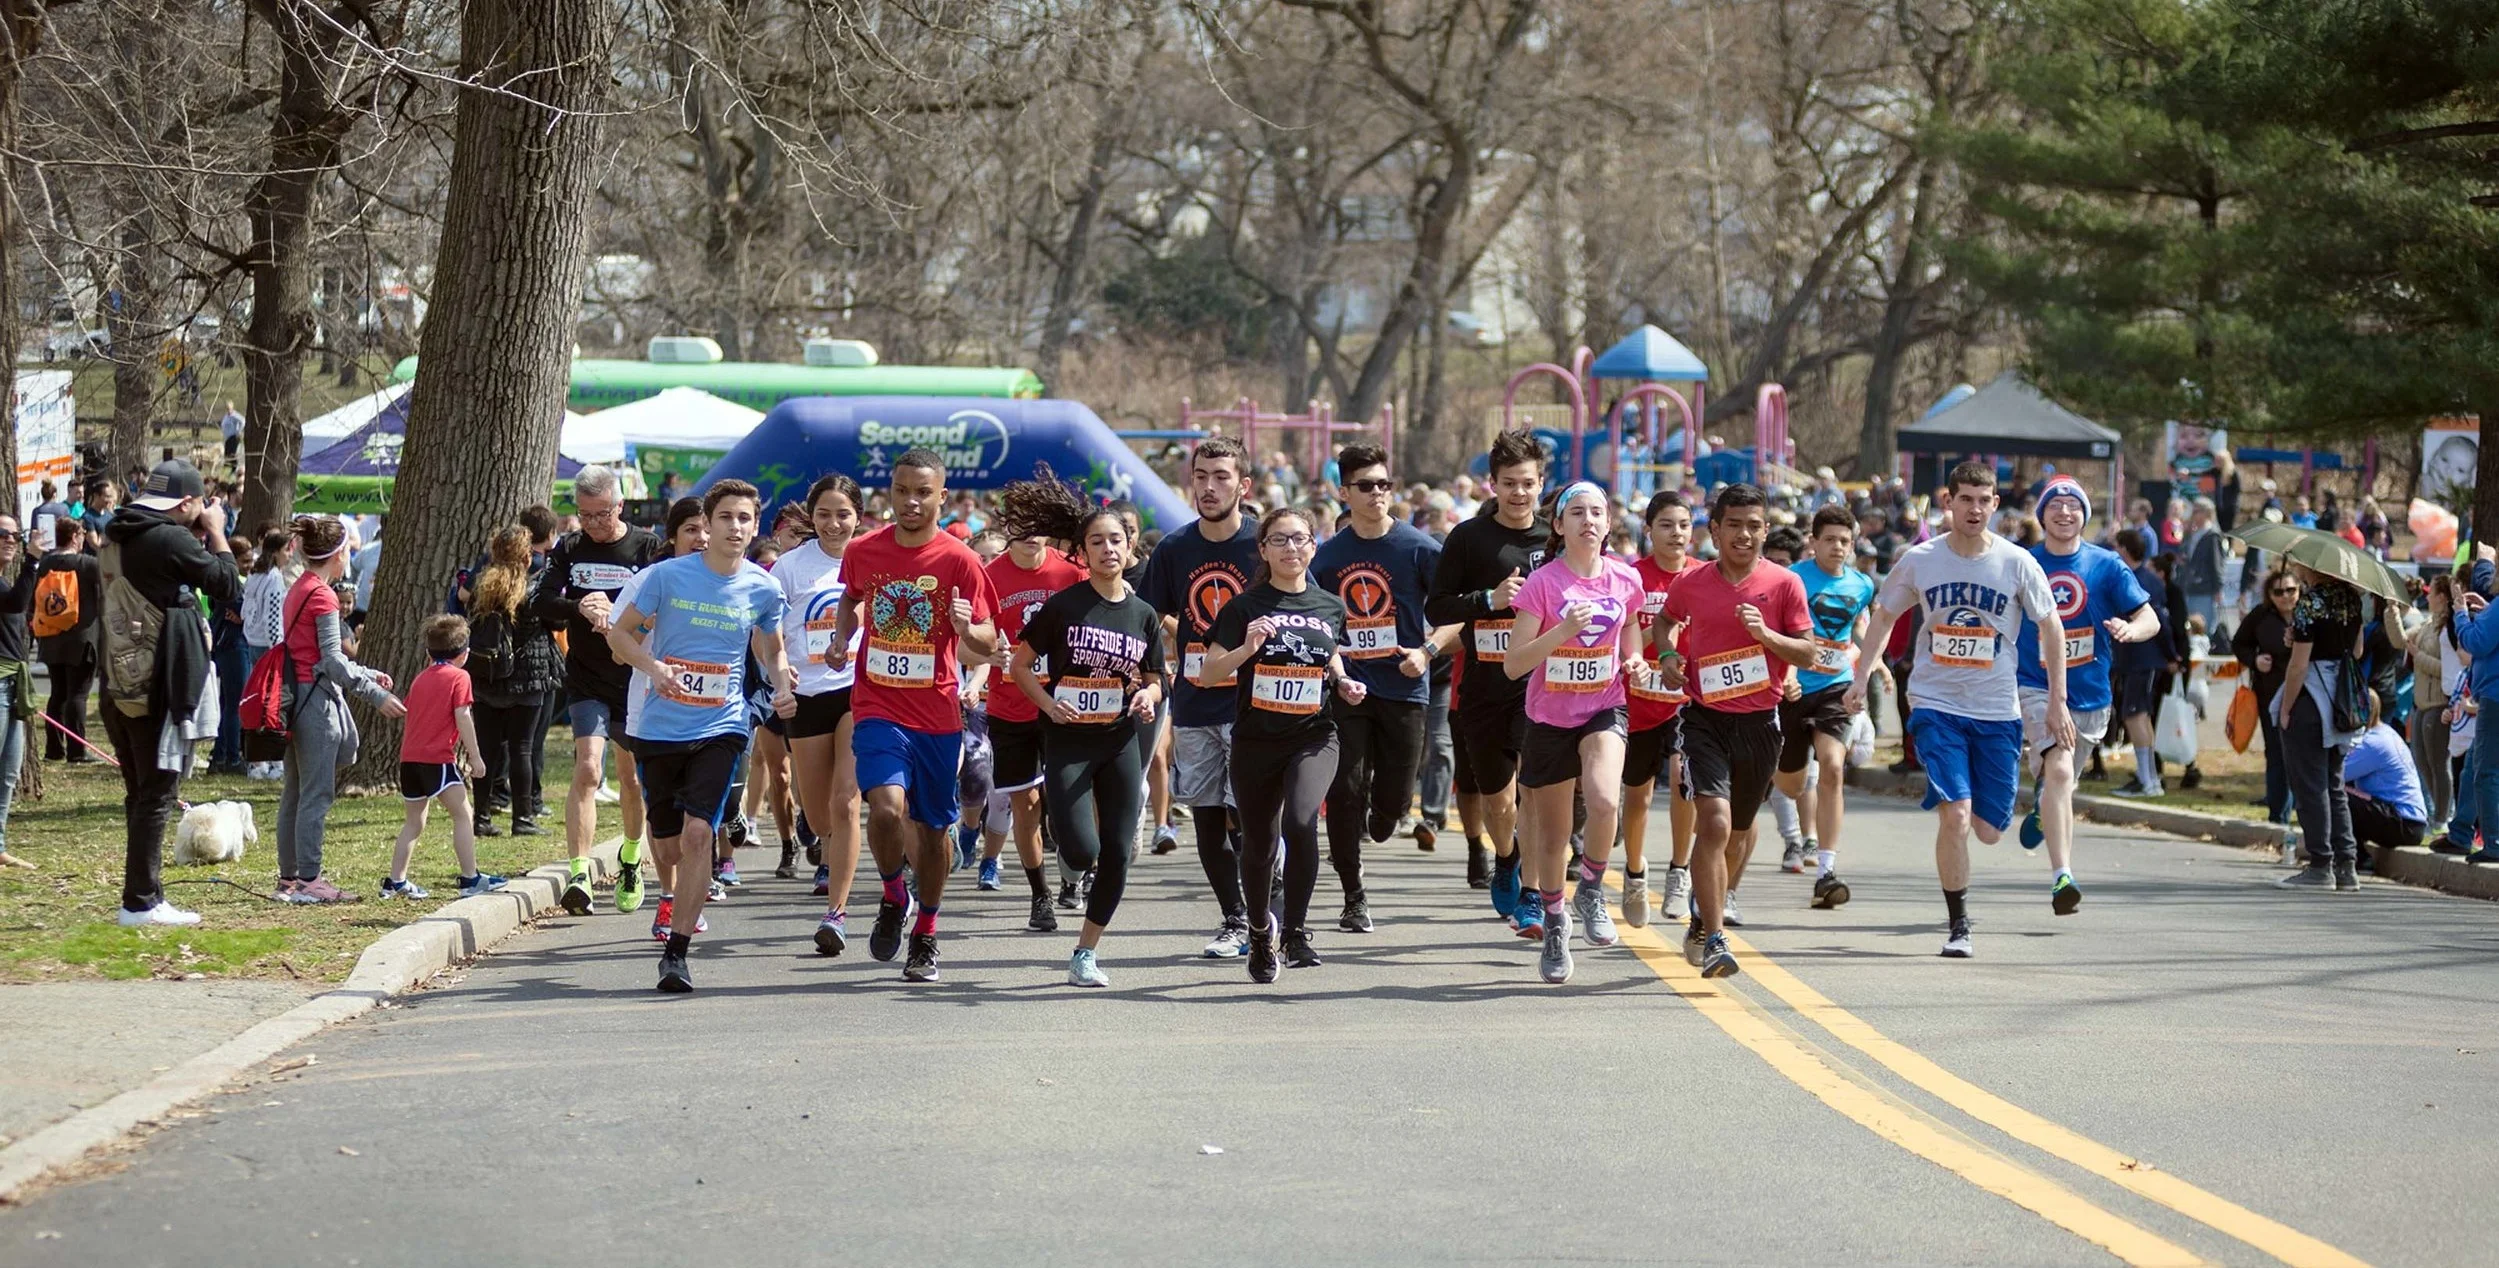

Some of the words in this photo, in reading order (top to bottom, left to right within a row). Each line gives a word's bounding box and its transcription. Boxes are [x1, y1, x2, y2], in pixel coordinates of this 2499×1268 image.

[858, 420, 968, 445] Second
[1228, 563, 1248, 584] Heart
[1374, 562, 1393, 582] Heart
[1925, 581, 2009, 616] VIKING
[690, 616, 718, 629] AUGUST
[1272, 614, 1334, 639] ROSS
[1964, 628, 1982, 637] HEART
[899, 644, 920, 655] HEART
[921, 646, 930, 655] 5K
[1067, 625, 1124, 655] CLIFFSIDE
[1358, 630, 1377, 649] 99
[1494, 631, 1511, 651] 10
[1948, 638, 1978, 657] 257
[1072, 648, 1109, 668] SPRING
[1109, 656, 1133, 676] TRAC
[1554, 648, 1582, 658] AYDEN'S
[1583, 649, 1602, 659] HEART
[1729, 647, 1750, 660] HEART
[695, 663, 716, 673] HEART
[717, 665, 727, 674] 5K
[887, 655, 909, 676] 83
[1257, 667, 1290, 677] HAYDEN'S
[1290, 668, 1310, 678] HEART
[1310, 669, 1319, 678] 5K
[1568, 660, 1598, 681] 195
[1721, 663, 1745, 686] 95
[683, 673, 704, 695] 84
[1090, 679, 1111, 688] HEART
[1274, 679, 1305, 701] 107
[1077, 690, 1100, 712] 90
